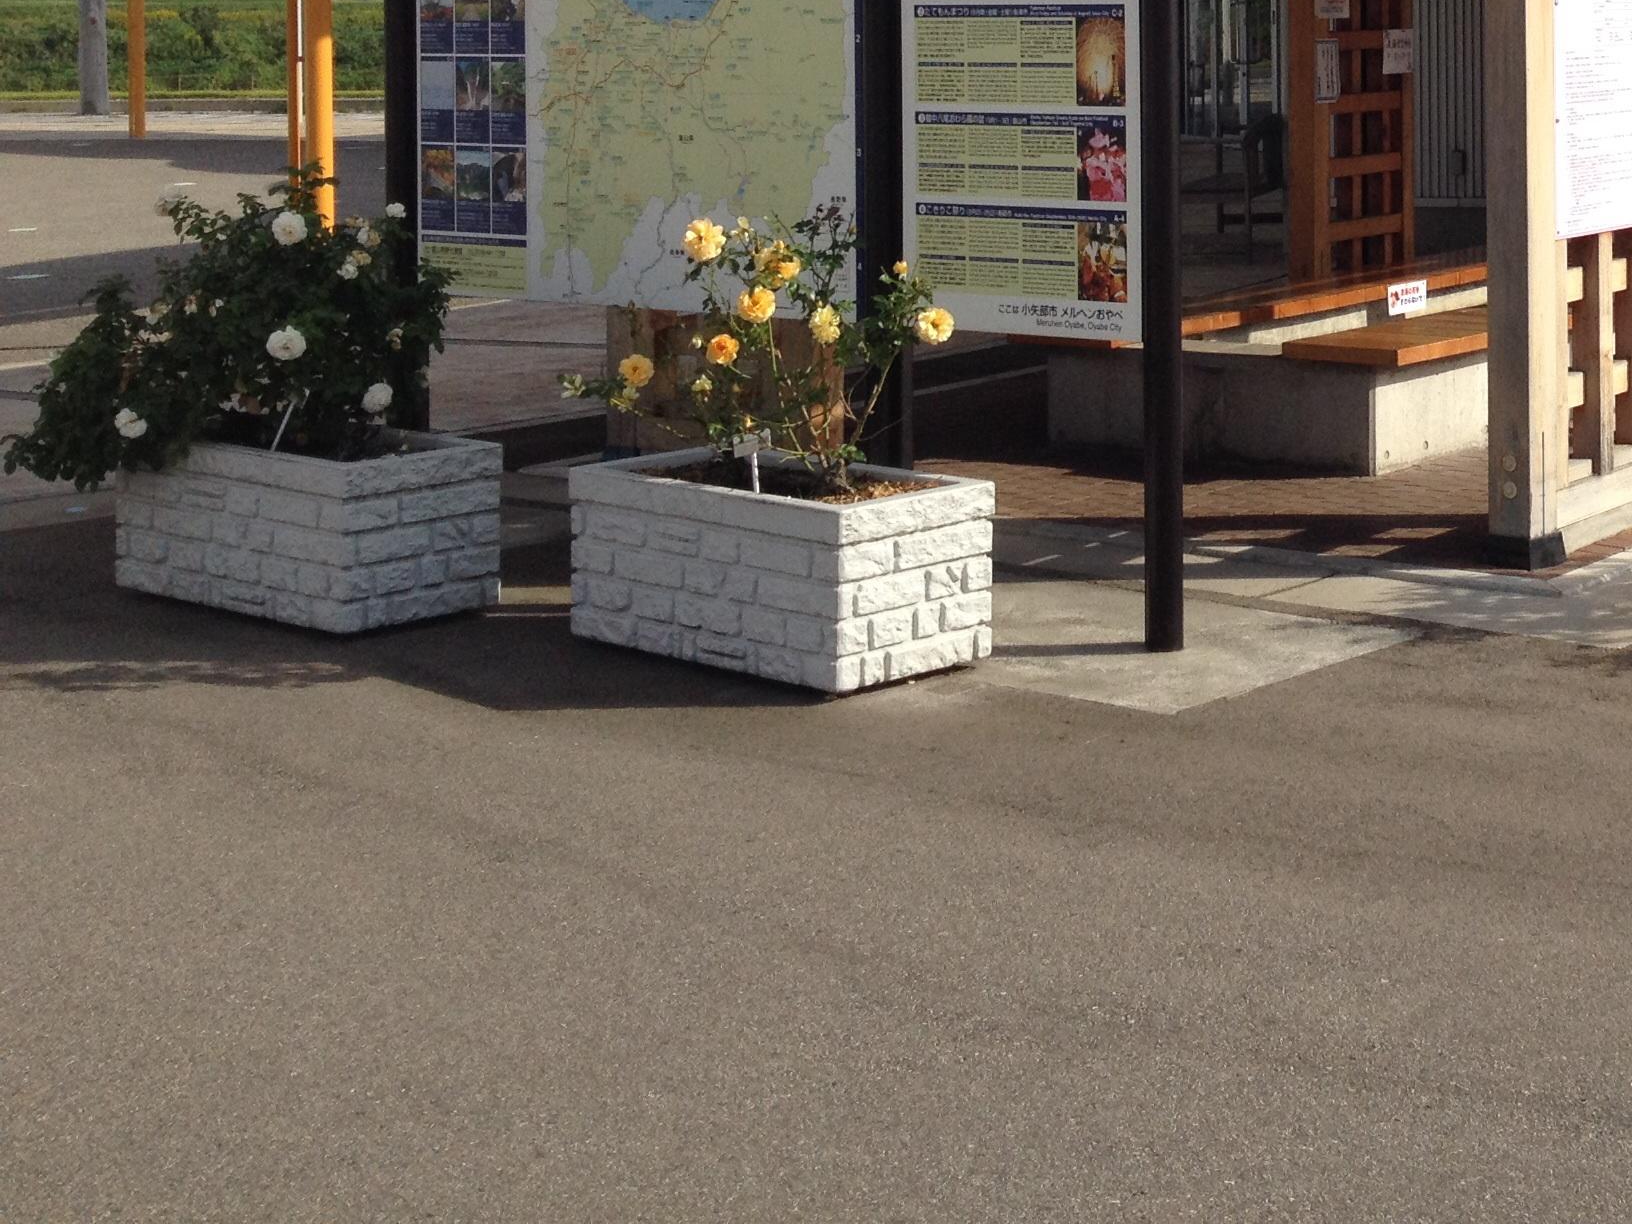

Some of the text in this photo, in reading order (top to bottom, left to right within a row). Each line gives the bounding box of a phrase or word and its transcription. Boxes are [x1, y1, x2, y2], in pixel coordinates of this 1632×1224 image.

[998, 304, 1019, 314] ここは
[1022, 303, 1058, 317] 小矢部市
